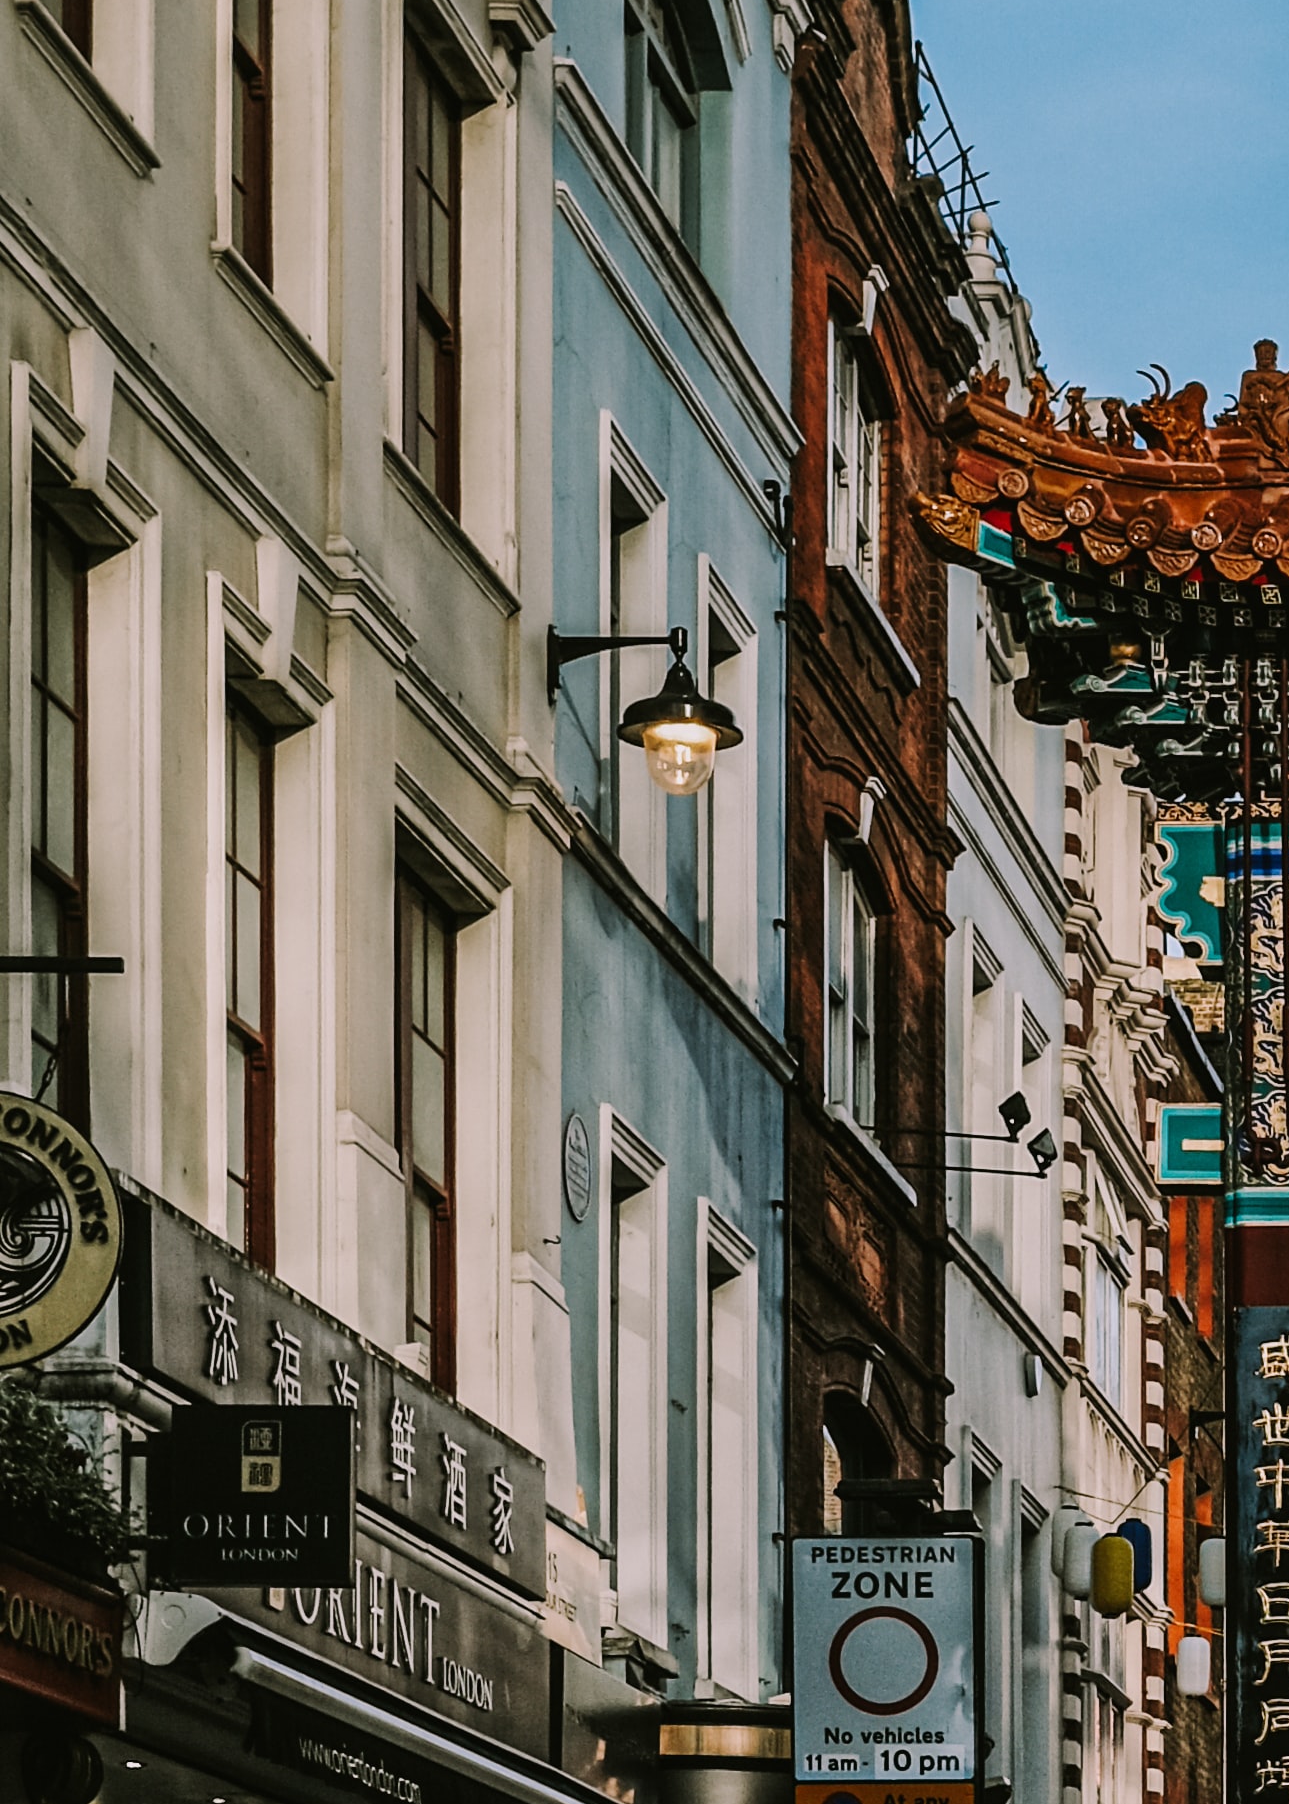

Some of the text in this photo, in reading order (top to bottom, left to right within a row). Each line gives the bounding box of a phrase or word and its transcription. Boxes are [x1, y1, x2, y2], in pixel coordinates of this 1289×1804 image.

[184, 1514, 337, 1539] ORIENT
[221, 1548, 299, 1562] LONDON
[811, 1546, 955, 1564] PEDESTRIAN
[832, 1571, 934, 1599] ZONE
[443, 1657, 494, 1711] LONDON
[824, 1726, 945, 1744] No vehicles
[805, 1754, 822, 1771] 11
[828, 1757, 858, 1771] am
[880, 1749, 912, 1772] 10
[919, 1754, 960, 1776] pm
